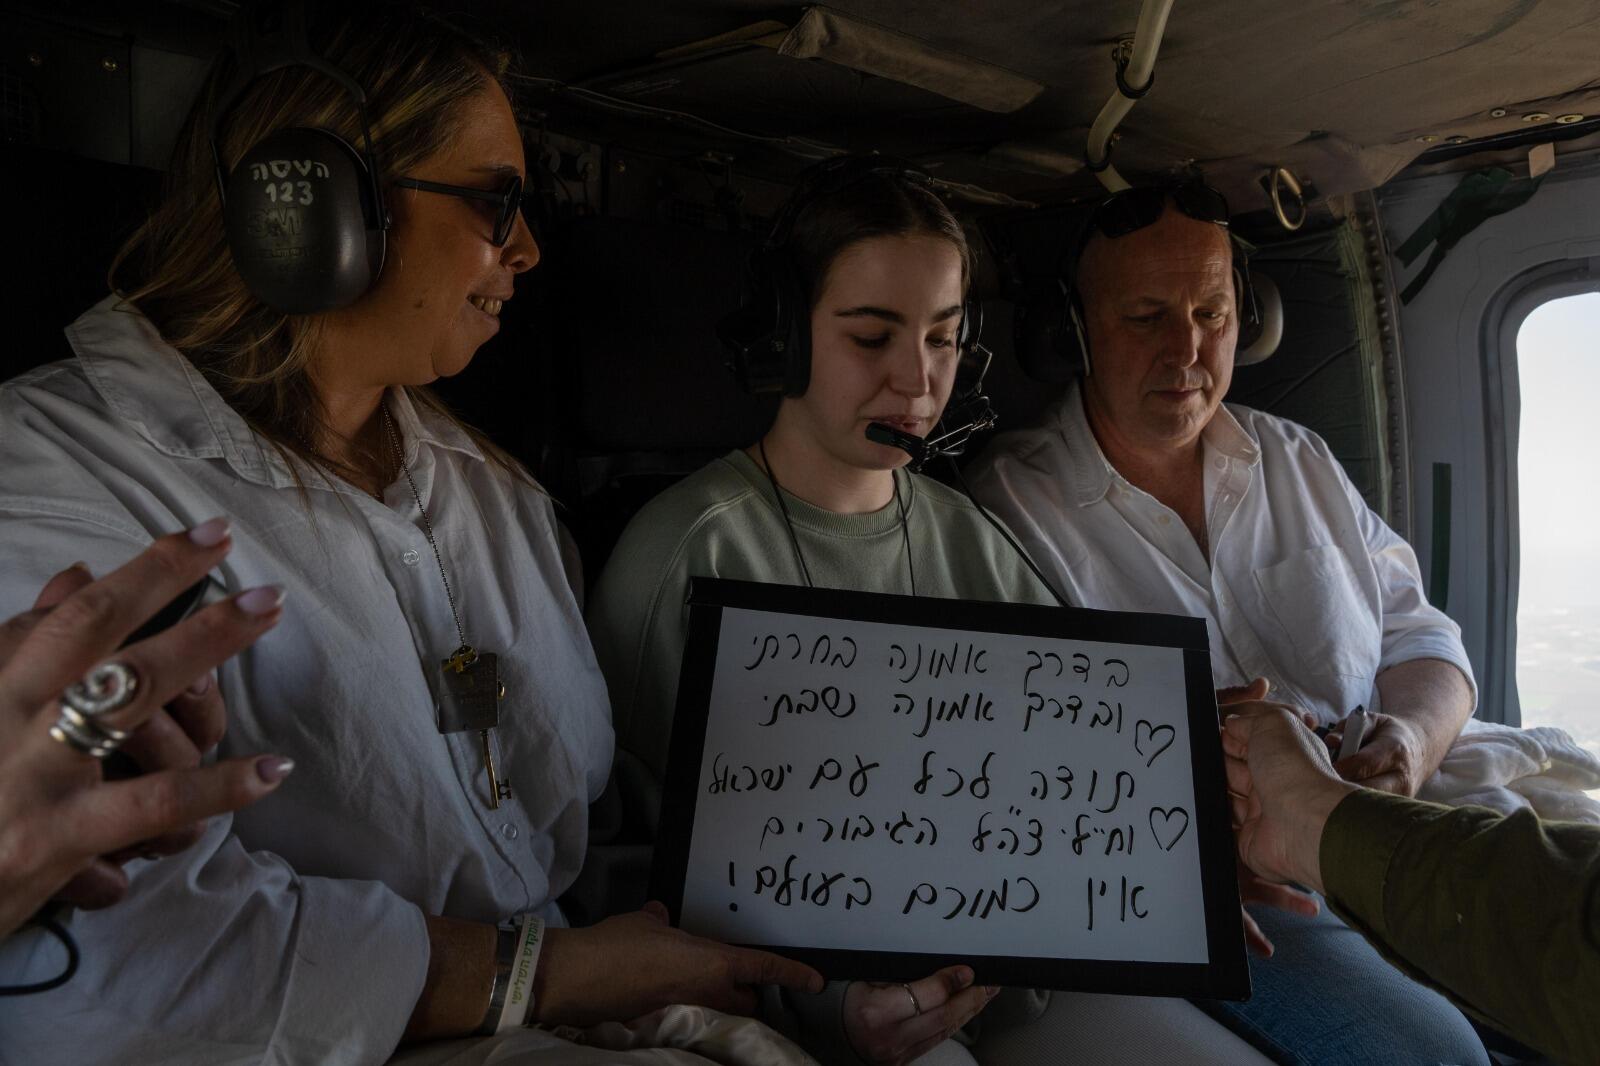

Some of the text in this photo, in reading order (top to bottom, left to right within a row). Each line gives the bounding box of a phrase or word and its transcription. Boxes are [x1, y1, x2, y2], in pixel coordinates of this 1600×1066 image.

[265, 181, 314, 206] 123
[743, 633, 1130, 697] בדרך אמונה בחרתי
[892, 691, 995, 739] אמונה
[1022, 691, 1123, 734] ובדרך
[708, 750, 1136, 814] תודה לכל עם ישראל
[759, 810, 938, 851] הגיבורים
[1060, 813, 1135, 857] וחיילי
[901, 876, 1041, 921] כמוכם
[1087, 875, 1149, 932] אין
